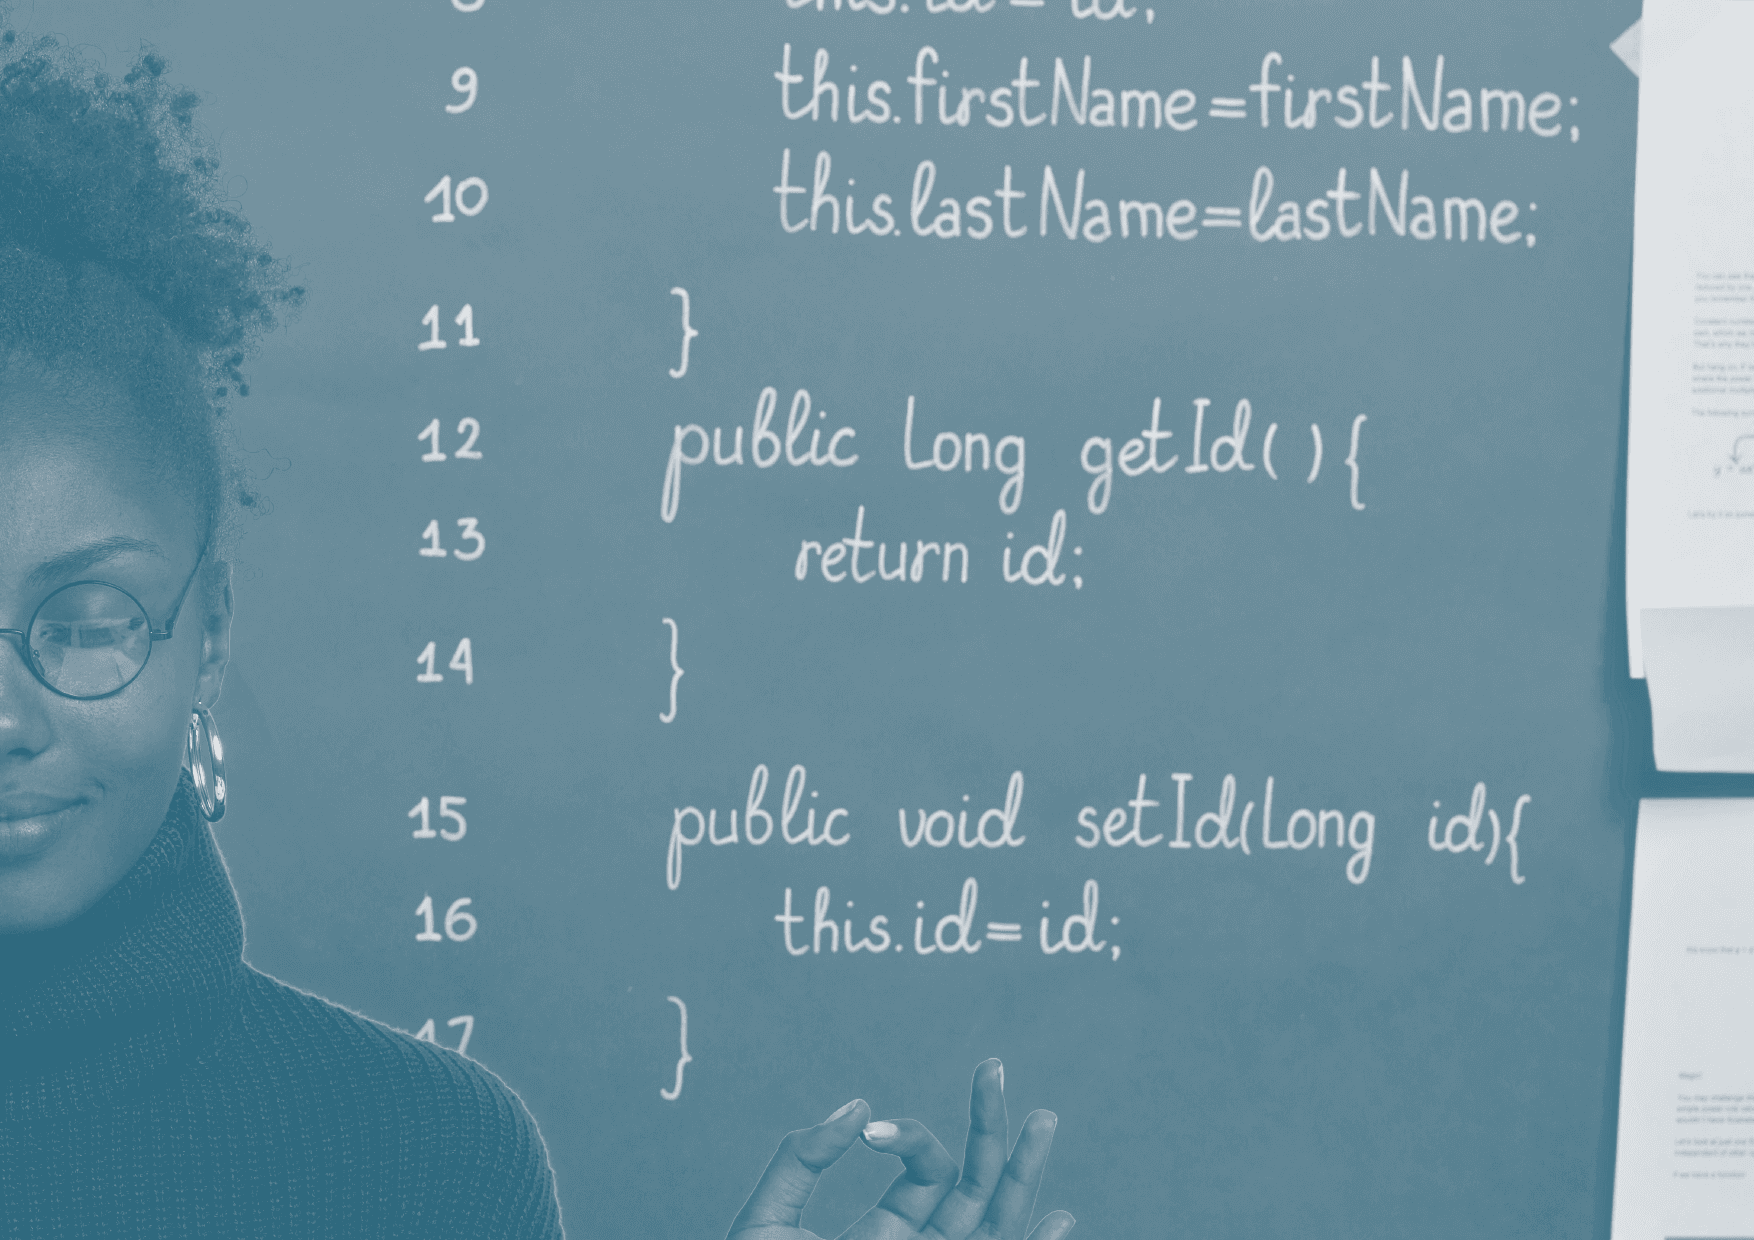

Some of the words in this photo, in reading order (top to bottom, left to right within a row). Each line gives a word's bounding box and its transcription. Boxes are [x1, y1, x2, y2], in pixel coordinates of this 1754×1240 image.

[445, 66, 478, 114] 9
[423, 174, 489, 223] 10
[417, 303, 481, 351] 11
[668, 286, 699, 379] }
[417, 416, 484, 463] 12
[660, 385, 860, 523] public
[418, 516, 486, 562] 13
[794, 504, 969, 584] return
[1002, 508, 1084, 591] id;
[416, 637, 474, 686] 14
[658, 617, 685, 724] }
[407, 795, 467, 842] 15
[666, 763, 851, 890] public
[898, 770, 1026, 849] void
[415, 895, 478, 942] 16
[660, 995, 693, 1101] }
